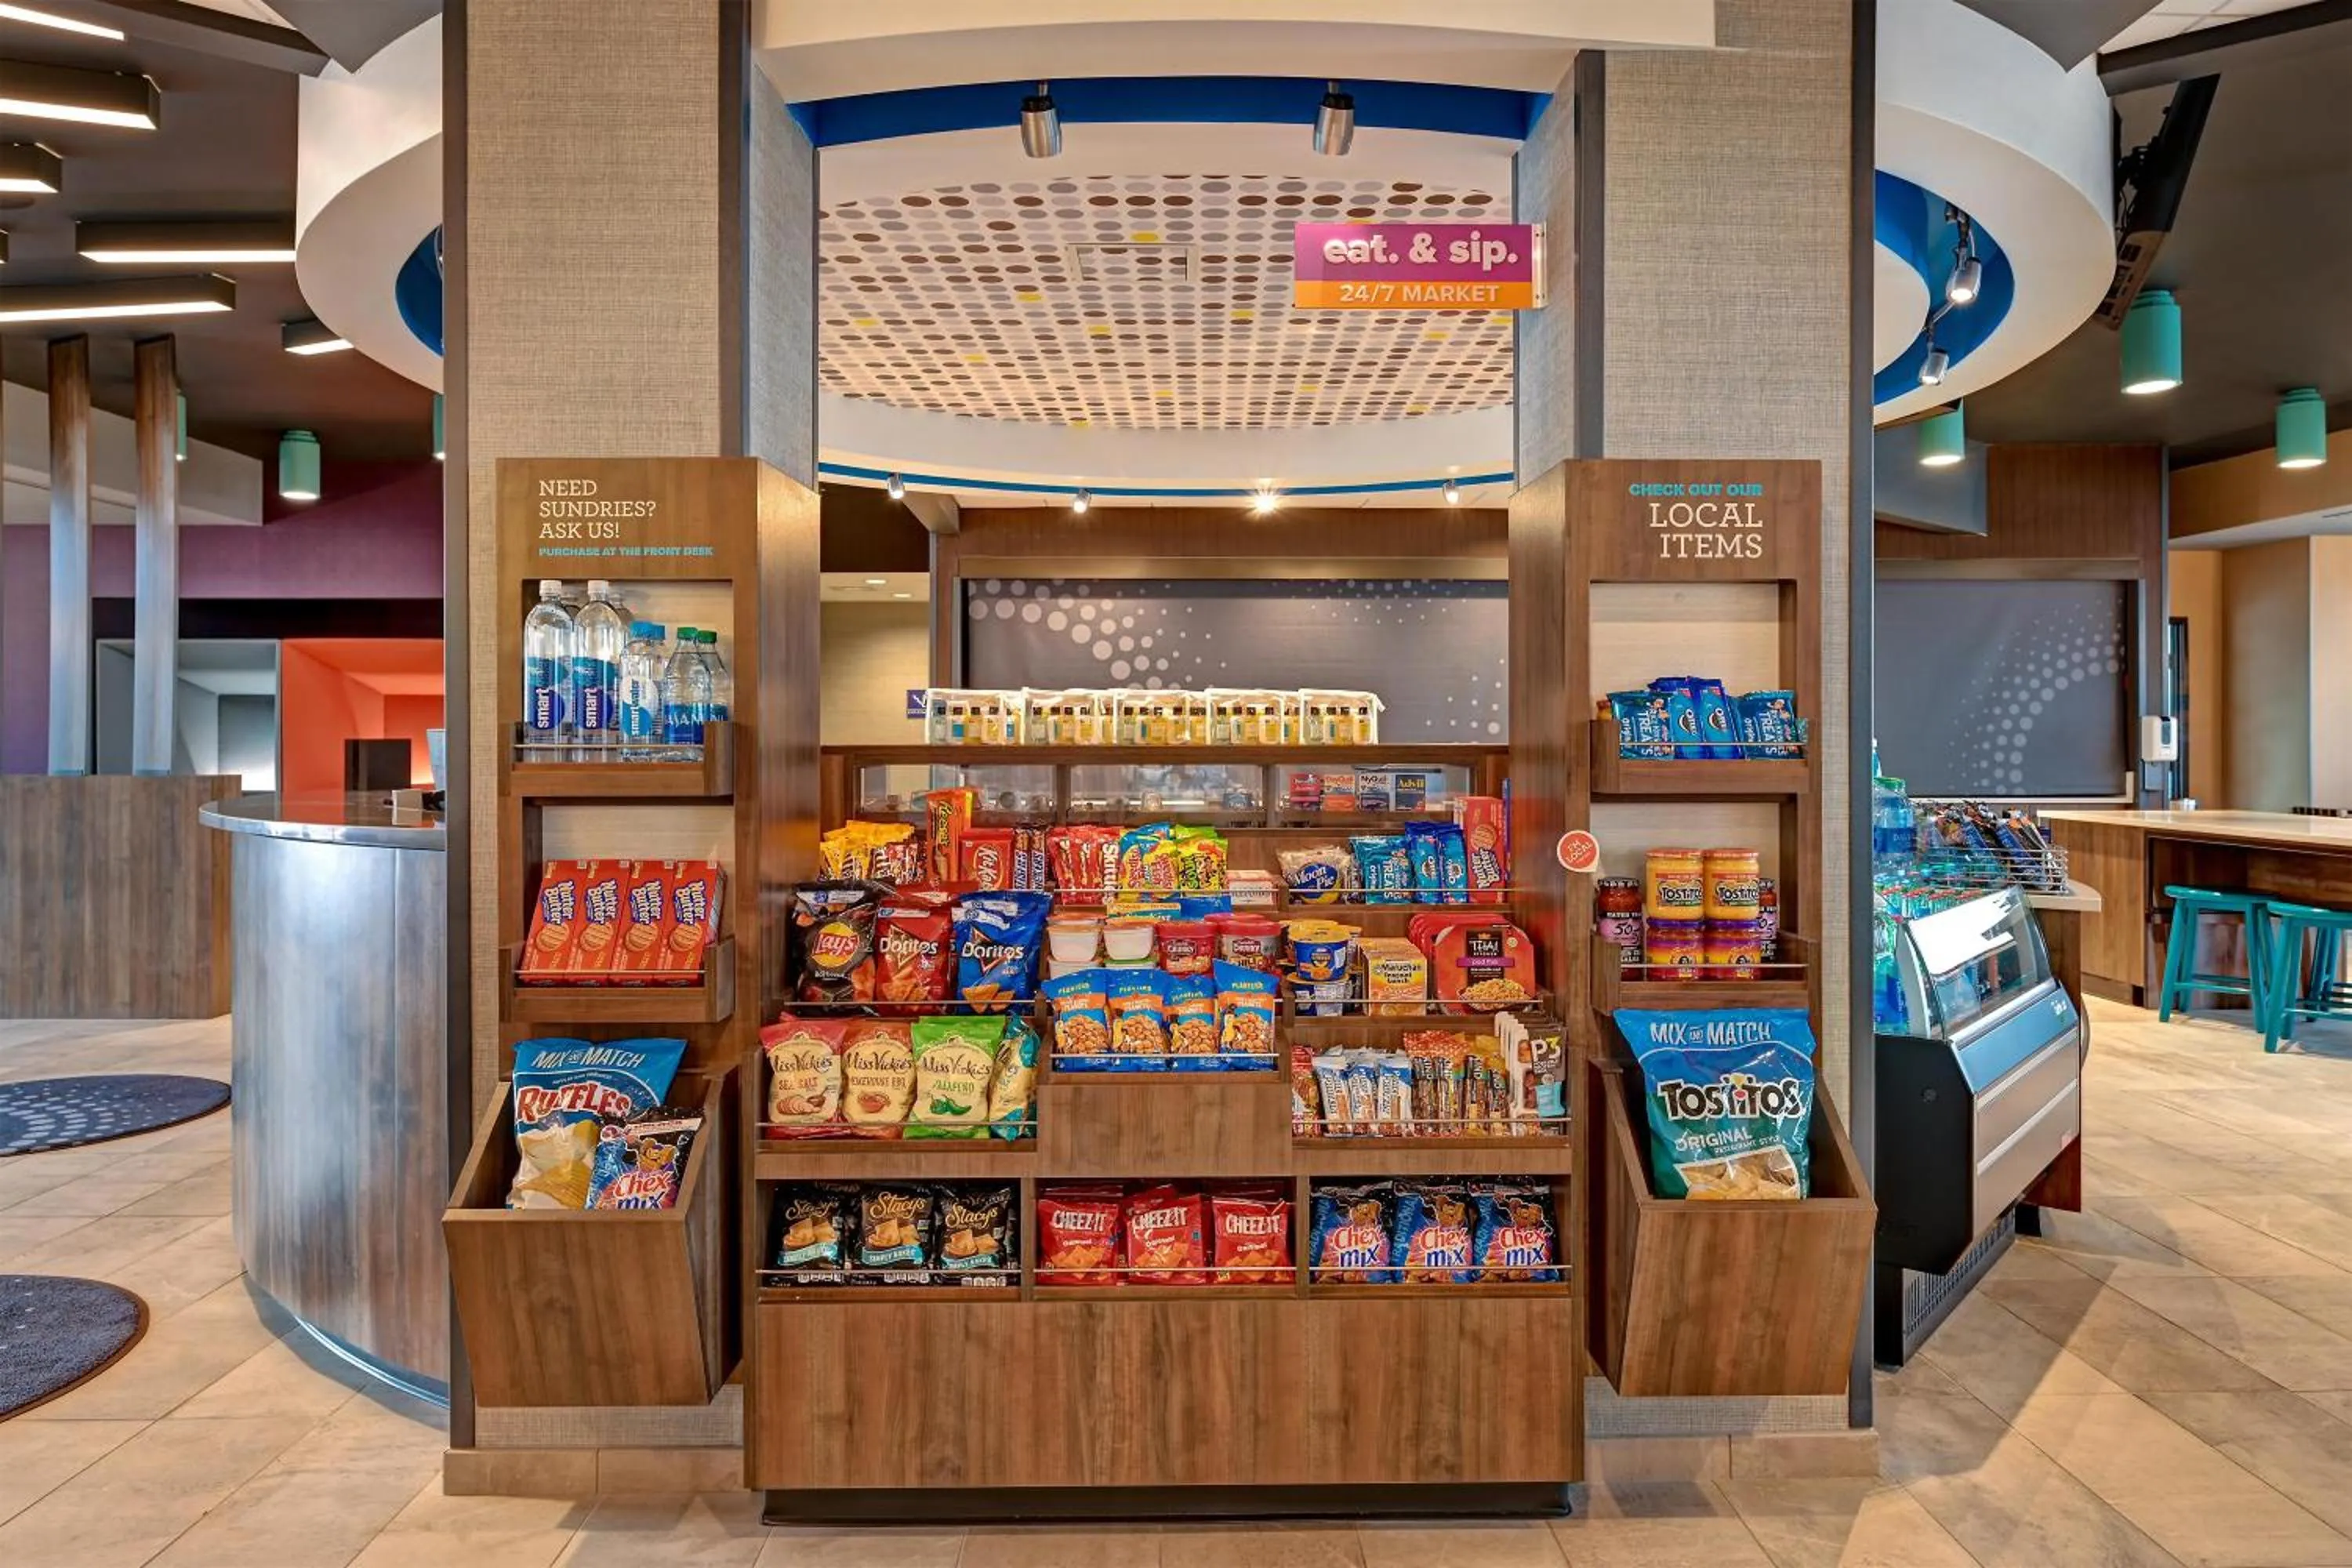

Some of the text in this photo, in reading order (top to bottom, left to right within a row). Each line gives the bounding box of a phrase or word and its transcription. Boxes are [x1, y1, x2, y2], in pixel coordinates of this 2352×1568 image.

[1323, 230, 1519, 271] eat. & sip.
[1339, 284, 1500, 303] 24/7 MARKET
[539, 479, 597, 497] NEED
[1629, 483, 1763, 496] CHECK OUT OUR
[539, 500, 657, 517] SUNDRIES?
[1649, 503, 1763, 528] LOCAL
[539, 521, 620, 539] ASK US!
[1660, 533, 1763, 559] ITEMS
[1399, 778, 1425, 788] Advil
[544, 886, 562, 925] Butter
[587, 887, 606, 925] Butter
[631, 887, 650, 925] Butter
[675, 887, 694, 925] Butter
[879, 937, 938, 955] Doritos
[961, 941, 1025, 960] Doritos
[1650, 1022, 1687, 1045] MIX
[1708, 1022, 1772, 1045] MATCH
[531, 1050, 570, 1069] MIX
[579, 1047, 647, 1069] MATCH
[519, 1081, 632, 1123] RUFFLES
[1658, 1073, 1805, 1120] TOSTITOS
[1675, 1127, 1753, 1152] ORIGINAL
[615, 1171, 672, 1196] Chex
[869, 1191, 926, 1219] Stacy's
[945, 1201, 998, 1229] Stacy's
[1052, 1210, 1106, 1231] CHEEZ-IT
[1225, 1213, 1280, 1235] CHEEZ-IT
[1333, 1225, 1381, 1250] Chex
[1419, 1227, 1468, 1250] Chex
[1498, 1226, 1545, 1250] Chex
[1339, 1244, 1380, 1268] mix
[1425, 1245, 1466, 1267] mix
[1504, 1245, 1545, 1267] mix
